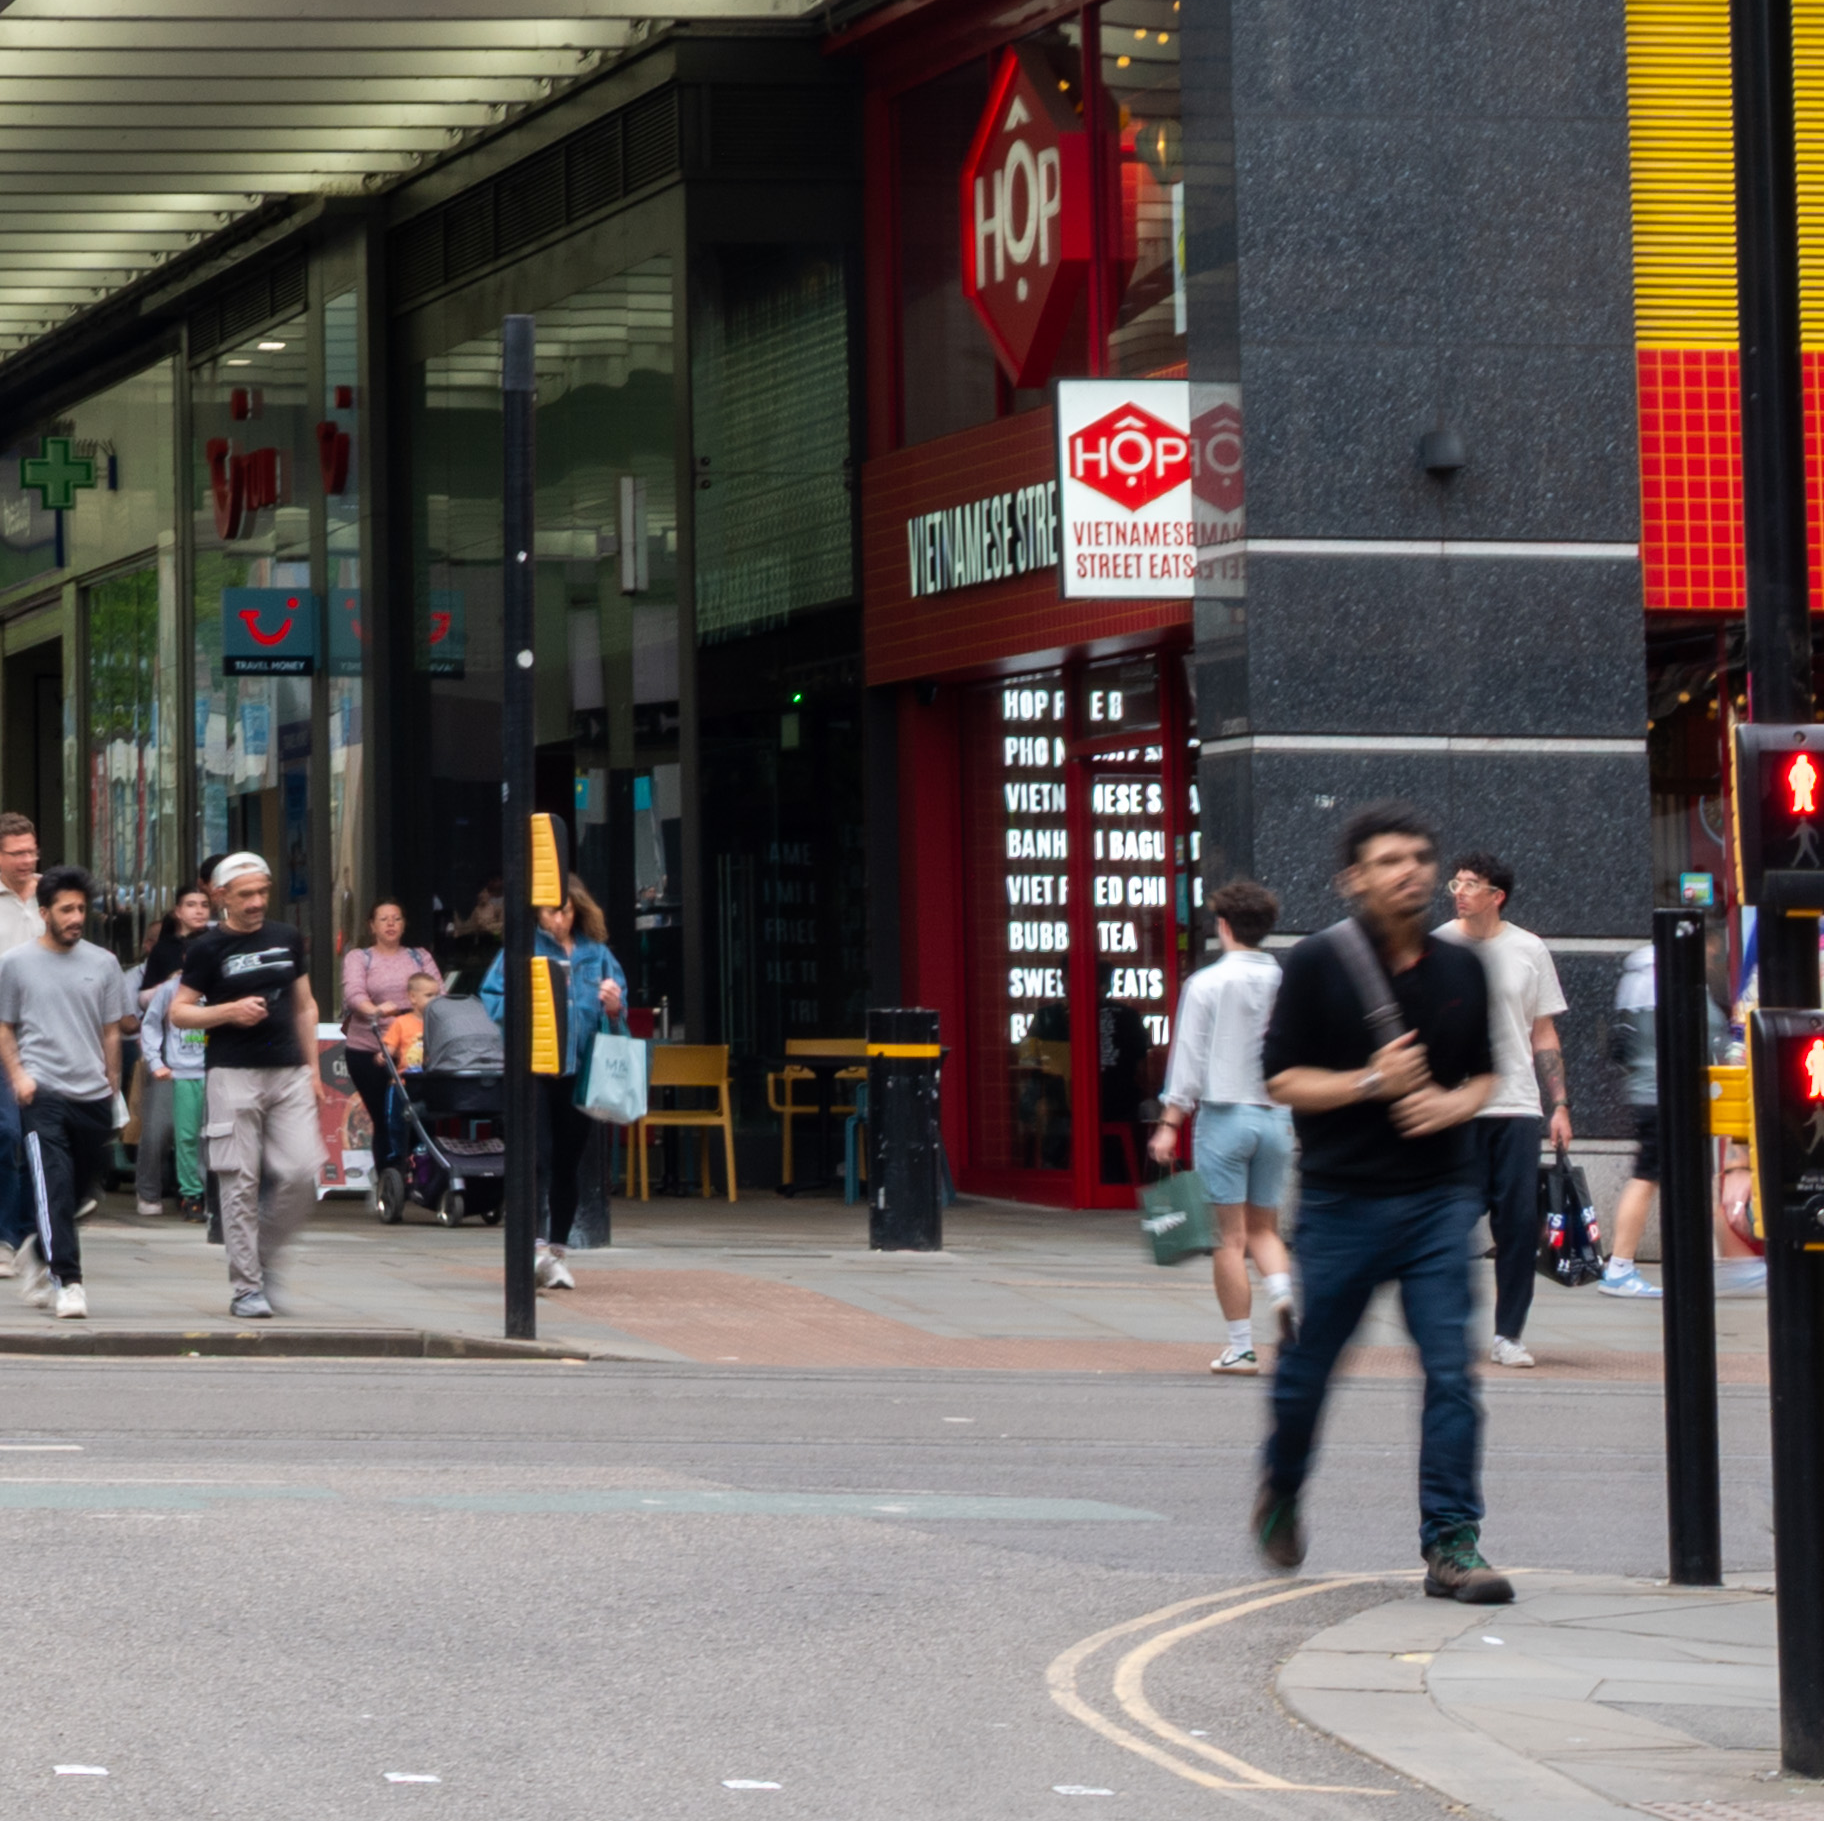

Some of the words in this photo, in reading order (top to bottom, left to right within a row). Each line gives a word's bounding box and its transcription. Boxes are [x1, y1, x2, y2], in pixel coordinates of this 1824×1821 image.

[907, 493, 1014, 598] VIETNAMESE
[1015, 480, 1058, 574] STRE
[1073, 521, 1194, 547] VIETNAMESE
[1076, 553, 1143, 579] STREET
[1150, 553, 1195, 580] EATS
[1003, 689, 1049, 721] HOP
[1004, 736, 1049, 767] PHO
[1006, 828, 1068, 859] BANH
[1006, 875, 1054, 905] VIET
[1008, 921, 1070, 952] BUBB
[1097, 921, 1138, 952] TEA
[1106, 967, 1164, 999] EATS
